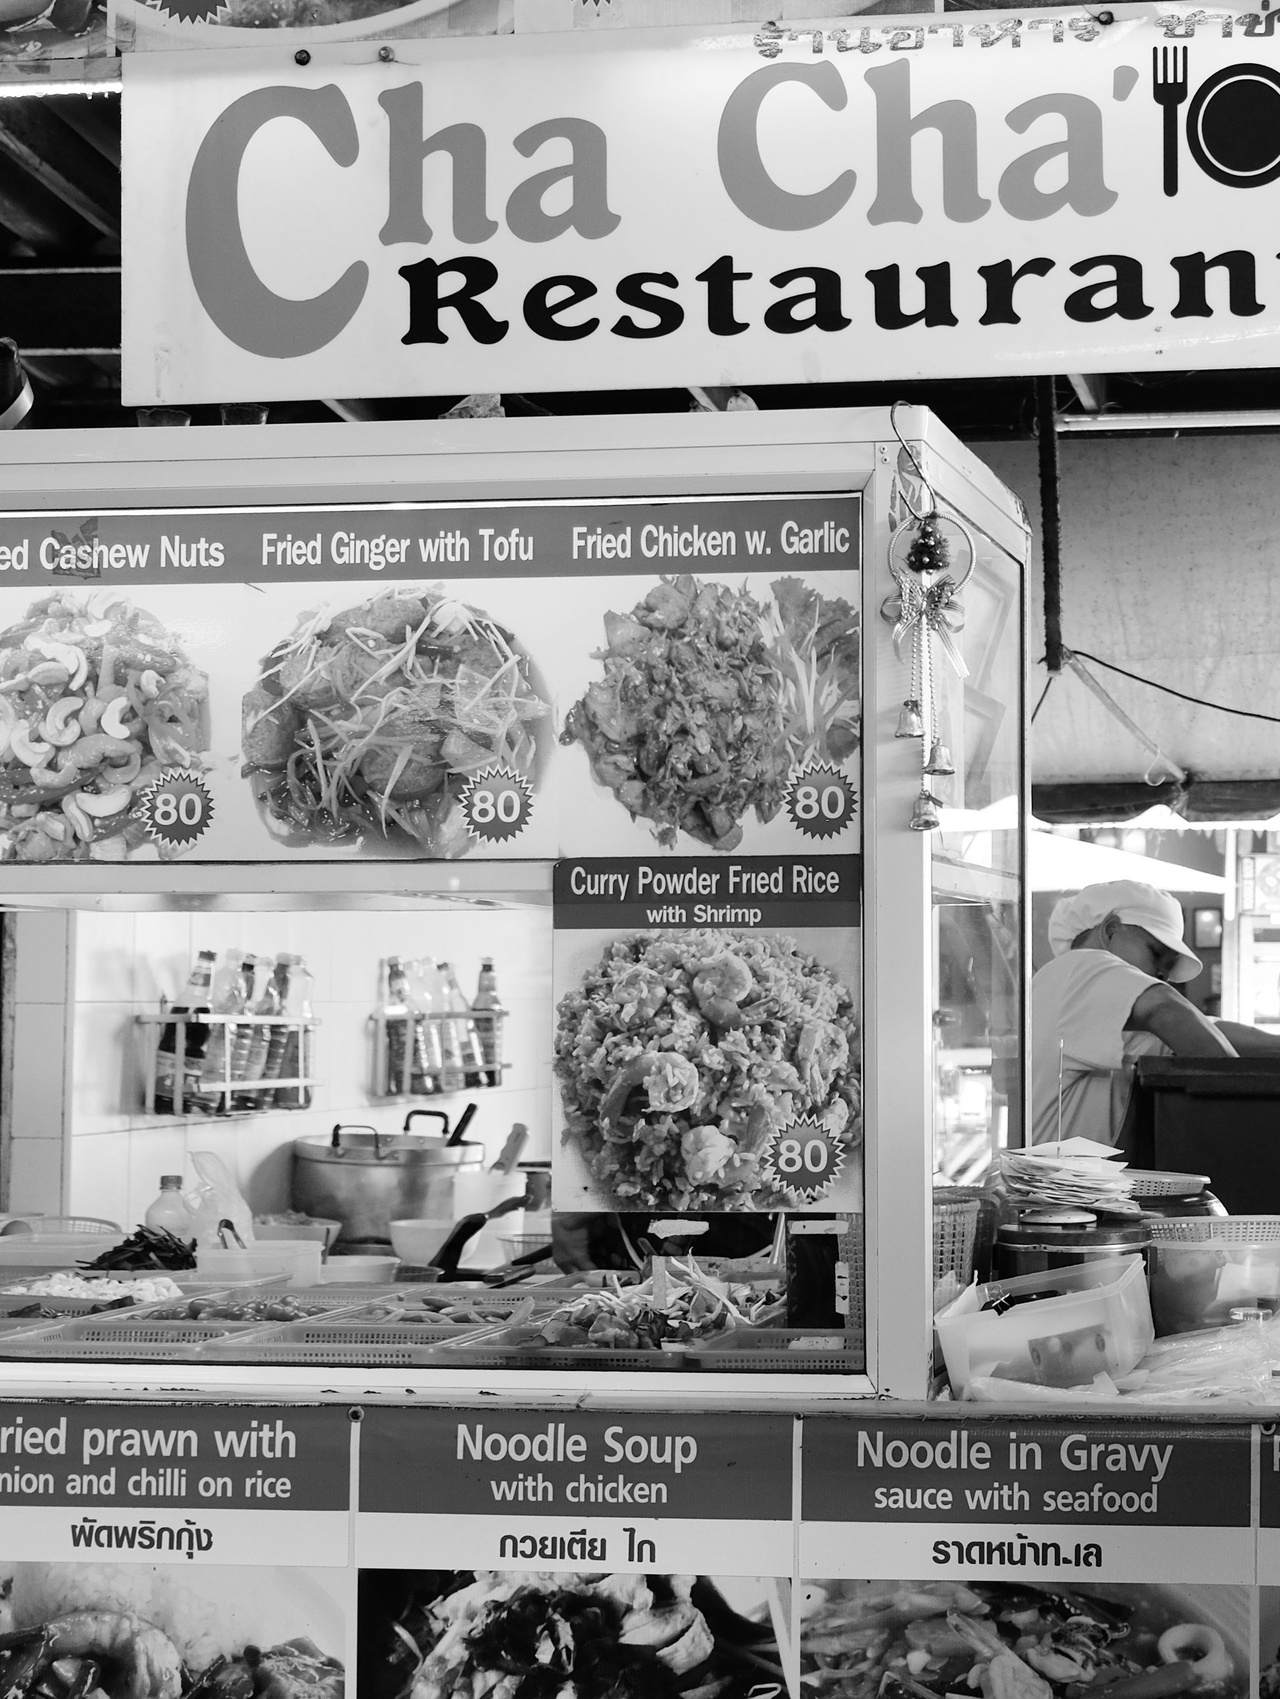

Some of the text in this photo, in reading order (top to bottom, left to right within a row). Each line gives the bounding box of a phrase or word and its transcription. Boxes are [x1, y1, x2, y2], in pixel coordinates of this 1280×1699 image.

[186, 80, 622, 360] Cha
[39, 536, 150, 570] Cashew
[160, 535, 226, 568] Nuts
[261, 527, 535, 571] Fried Ginger with Tofu
[572, 521, 851, 560] Fried Chicken w. Garlic
[154, 793, 202, 826] 80
[471, 791, 521, 824] 80
[794, 786, 845, 819] 80
[570, 865, 840, 901] Curry Powder Fried Rice
[646, 904, 762, 926] with Shrimp
[777, 1138, 829, 1173] 80
[82, 1426, 198, 1465] prawn
[214, 1420, 297, 1458] with
[456, 1423, 698, 1474] Noodle Soup
[856, 1430, 1174, 1482] Noodle in Gravy
[65, 1467, 116, 1495] and
[127, 1468, 187, 1496] chilli
[199, 1476, 233, 1498] on
[244, 1470, 292, 1499] rice
[490, 1473, 668, 1504] with chicken
[874, 1482, 1158, 1513] sauce with seafood
